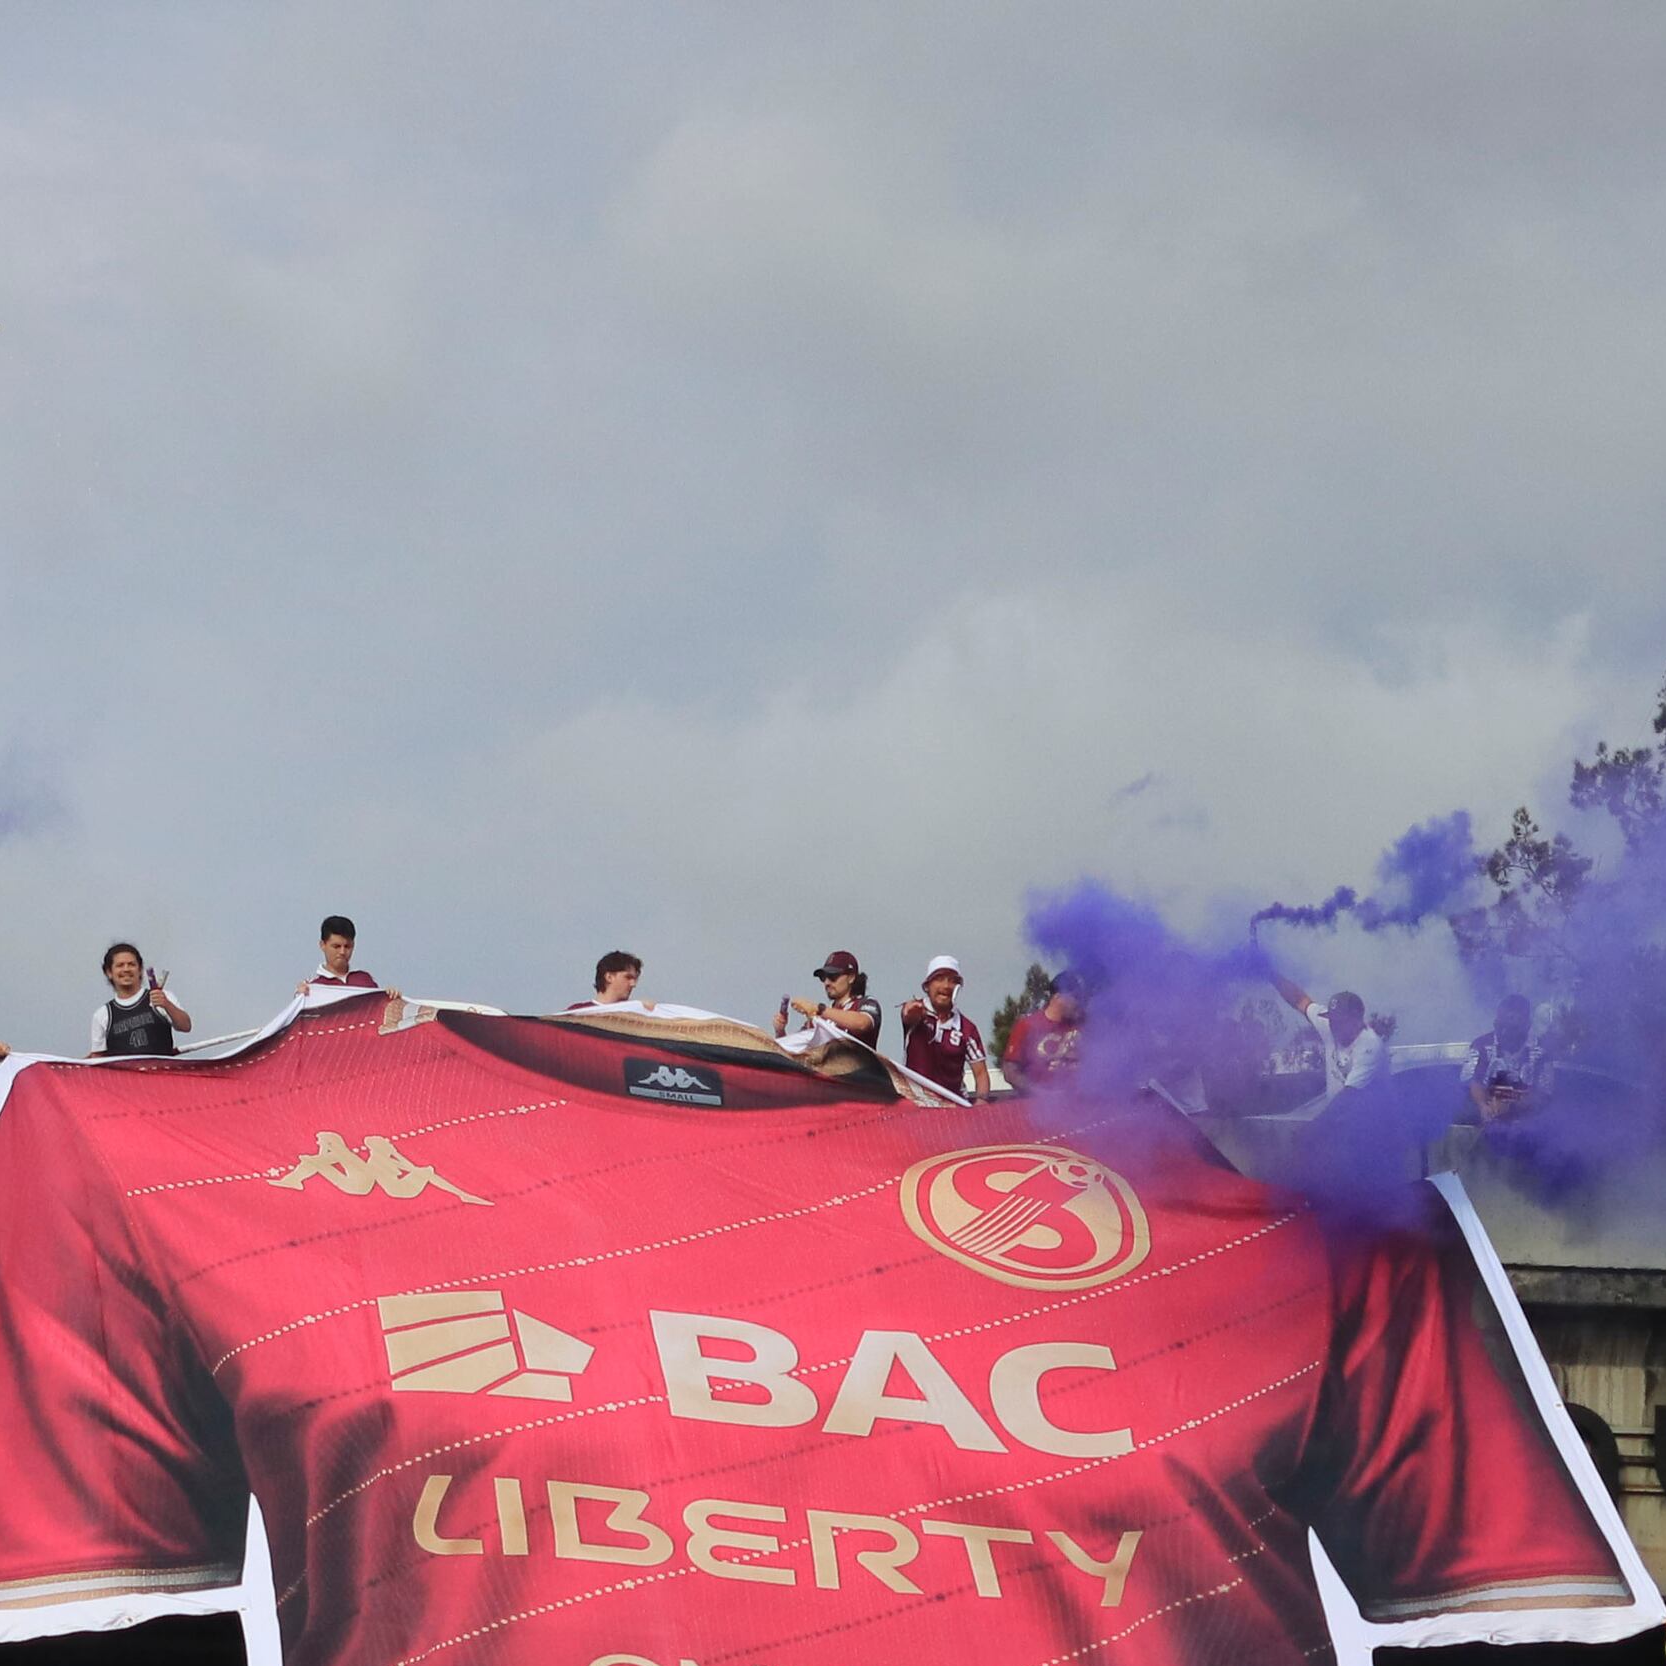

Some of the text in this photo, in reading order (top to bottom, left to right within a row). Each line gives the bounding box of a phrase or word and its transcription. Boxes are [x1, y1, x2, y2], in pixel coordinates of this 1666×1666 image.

[949, 1029, 964, 1047] S
[658, 1091, 695, 1102] SMALL
[648, 1309, 1135, 1458] BAC
[412, 1474, 1142, 1608] LIBERTY
